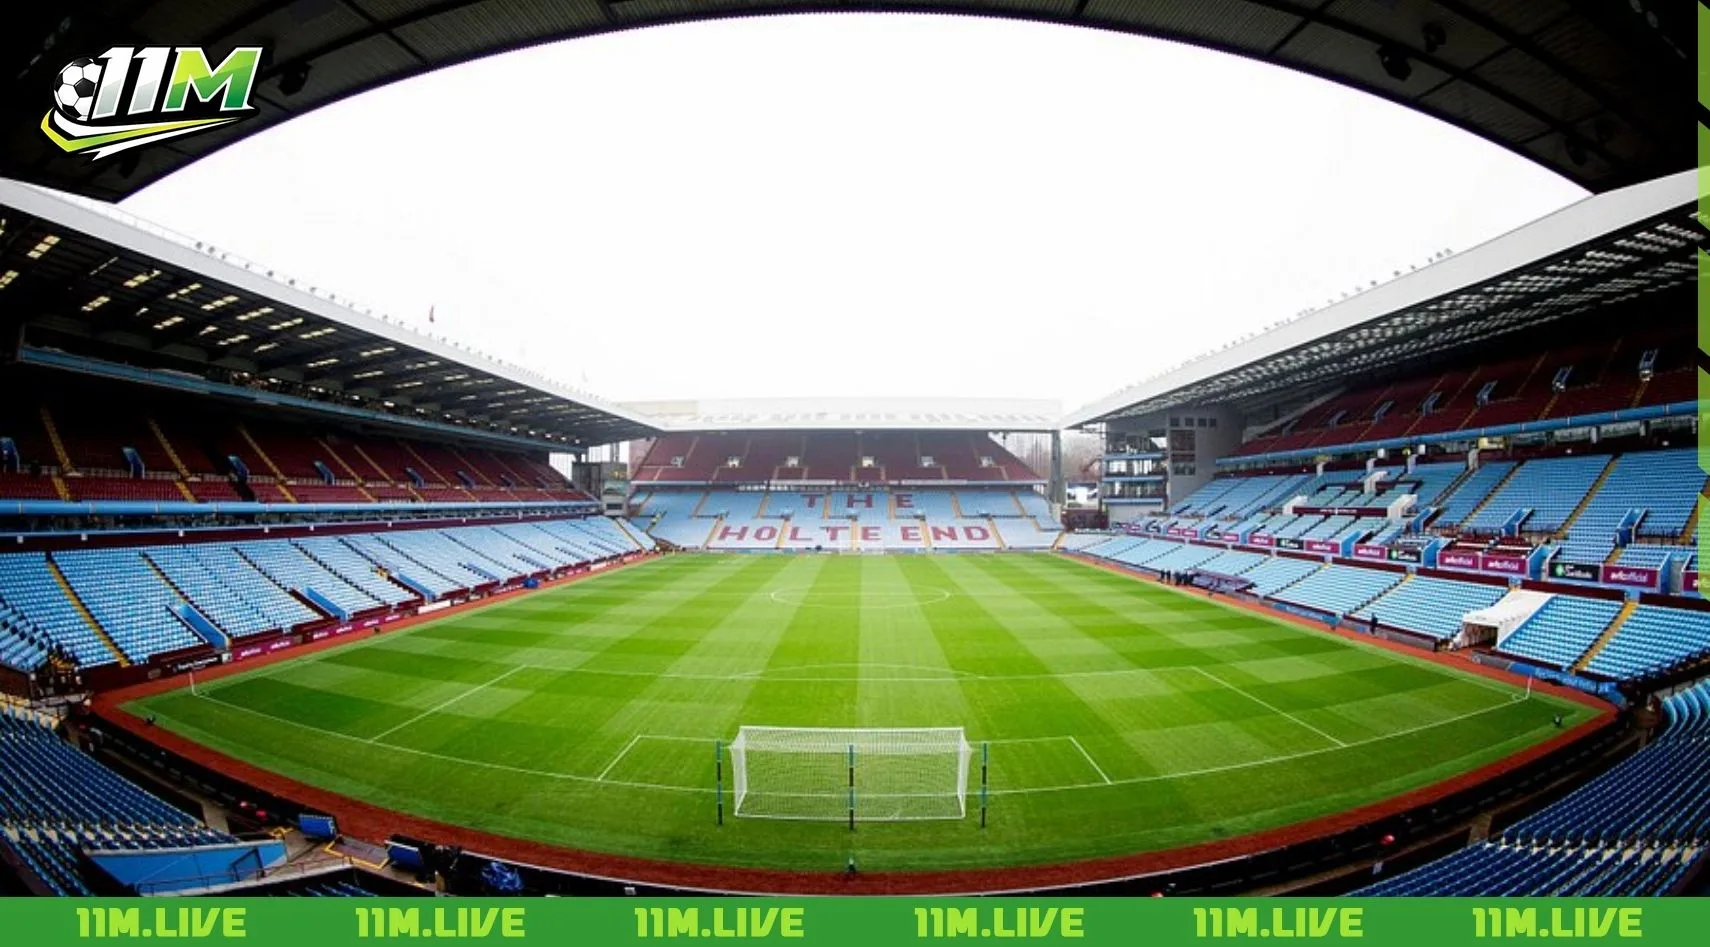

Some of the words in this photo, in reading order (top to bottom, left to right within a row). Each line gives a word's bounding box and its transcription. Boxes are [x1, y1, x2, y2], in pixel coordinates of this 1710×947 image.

[801, 494, 914, 508] THE
[718, 526, 881, 541] HOLTE
[900, 526, 990, 541] END
